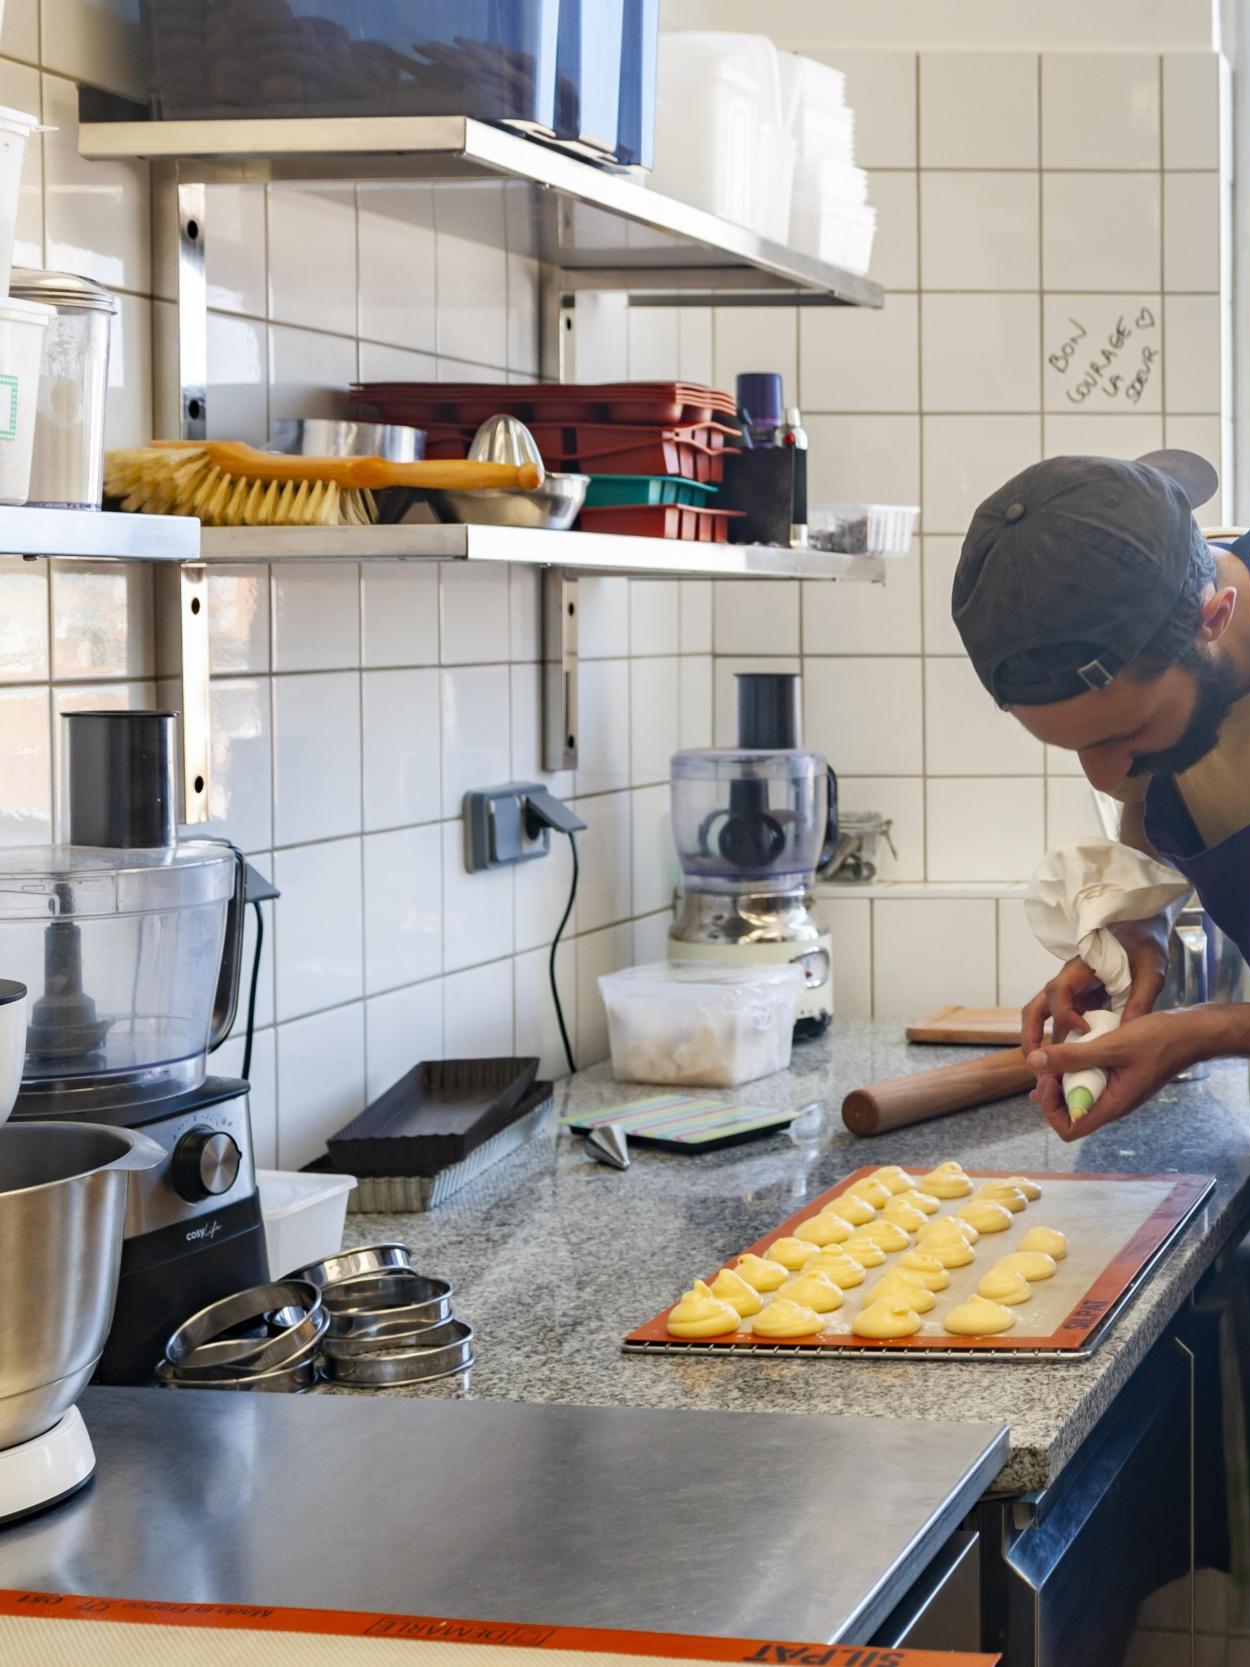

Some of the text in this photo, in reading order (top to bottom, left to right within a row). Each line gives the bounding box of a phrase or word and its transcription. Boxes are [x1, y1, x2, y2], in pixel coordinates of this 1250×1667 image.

[1048, 317, 1087, 373] BON
[1066, 315, 1131, 404] COURAGE
[1102, 375, 1124, 397] LA
[1063, 1299, 1106, 1330] SILPAT
[380, 1620, 509, 1640] DEMARLE
[743, 1644, 905, 1667] SILPAT
